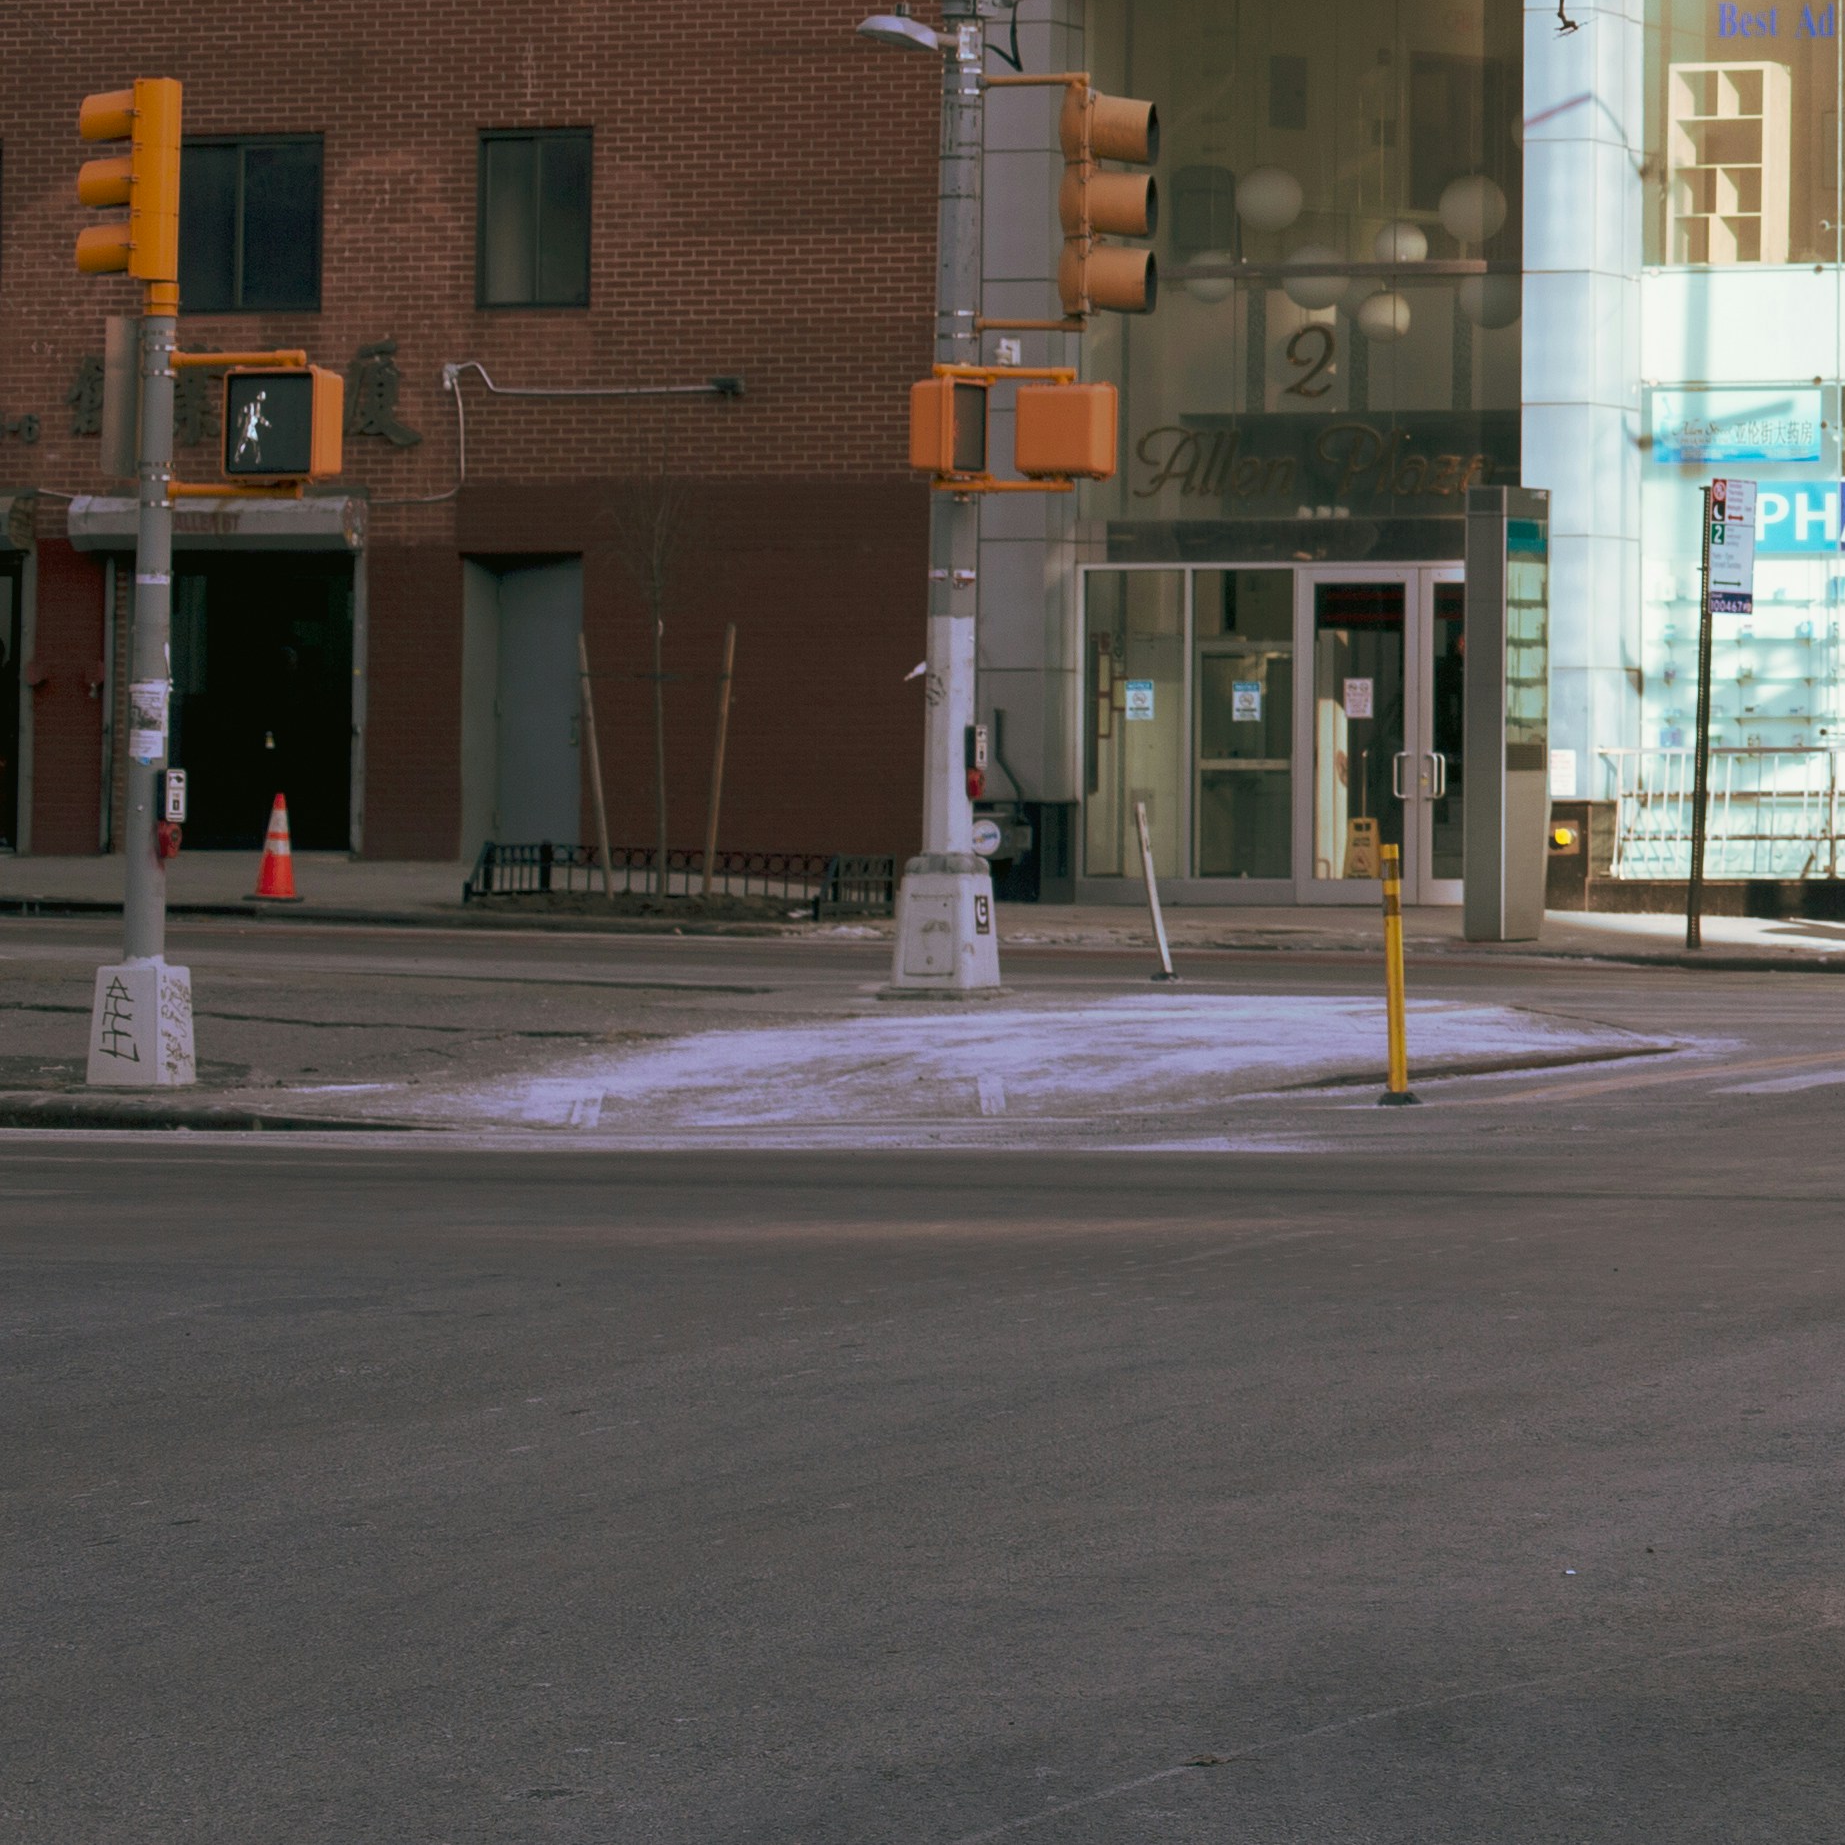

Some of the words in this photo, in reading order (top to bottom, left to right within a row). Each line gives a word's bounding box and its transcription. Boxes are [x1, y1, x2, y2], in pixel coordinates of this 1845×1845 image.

[1717, 3, 1778, 39] Best
[1285, 323, 1336, 398] 2
[1134, 425, 1296, 499] Allen
